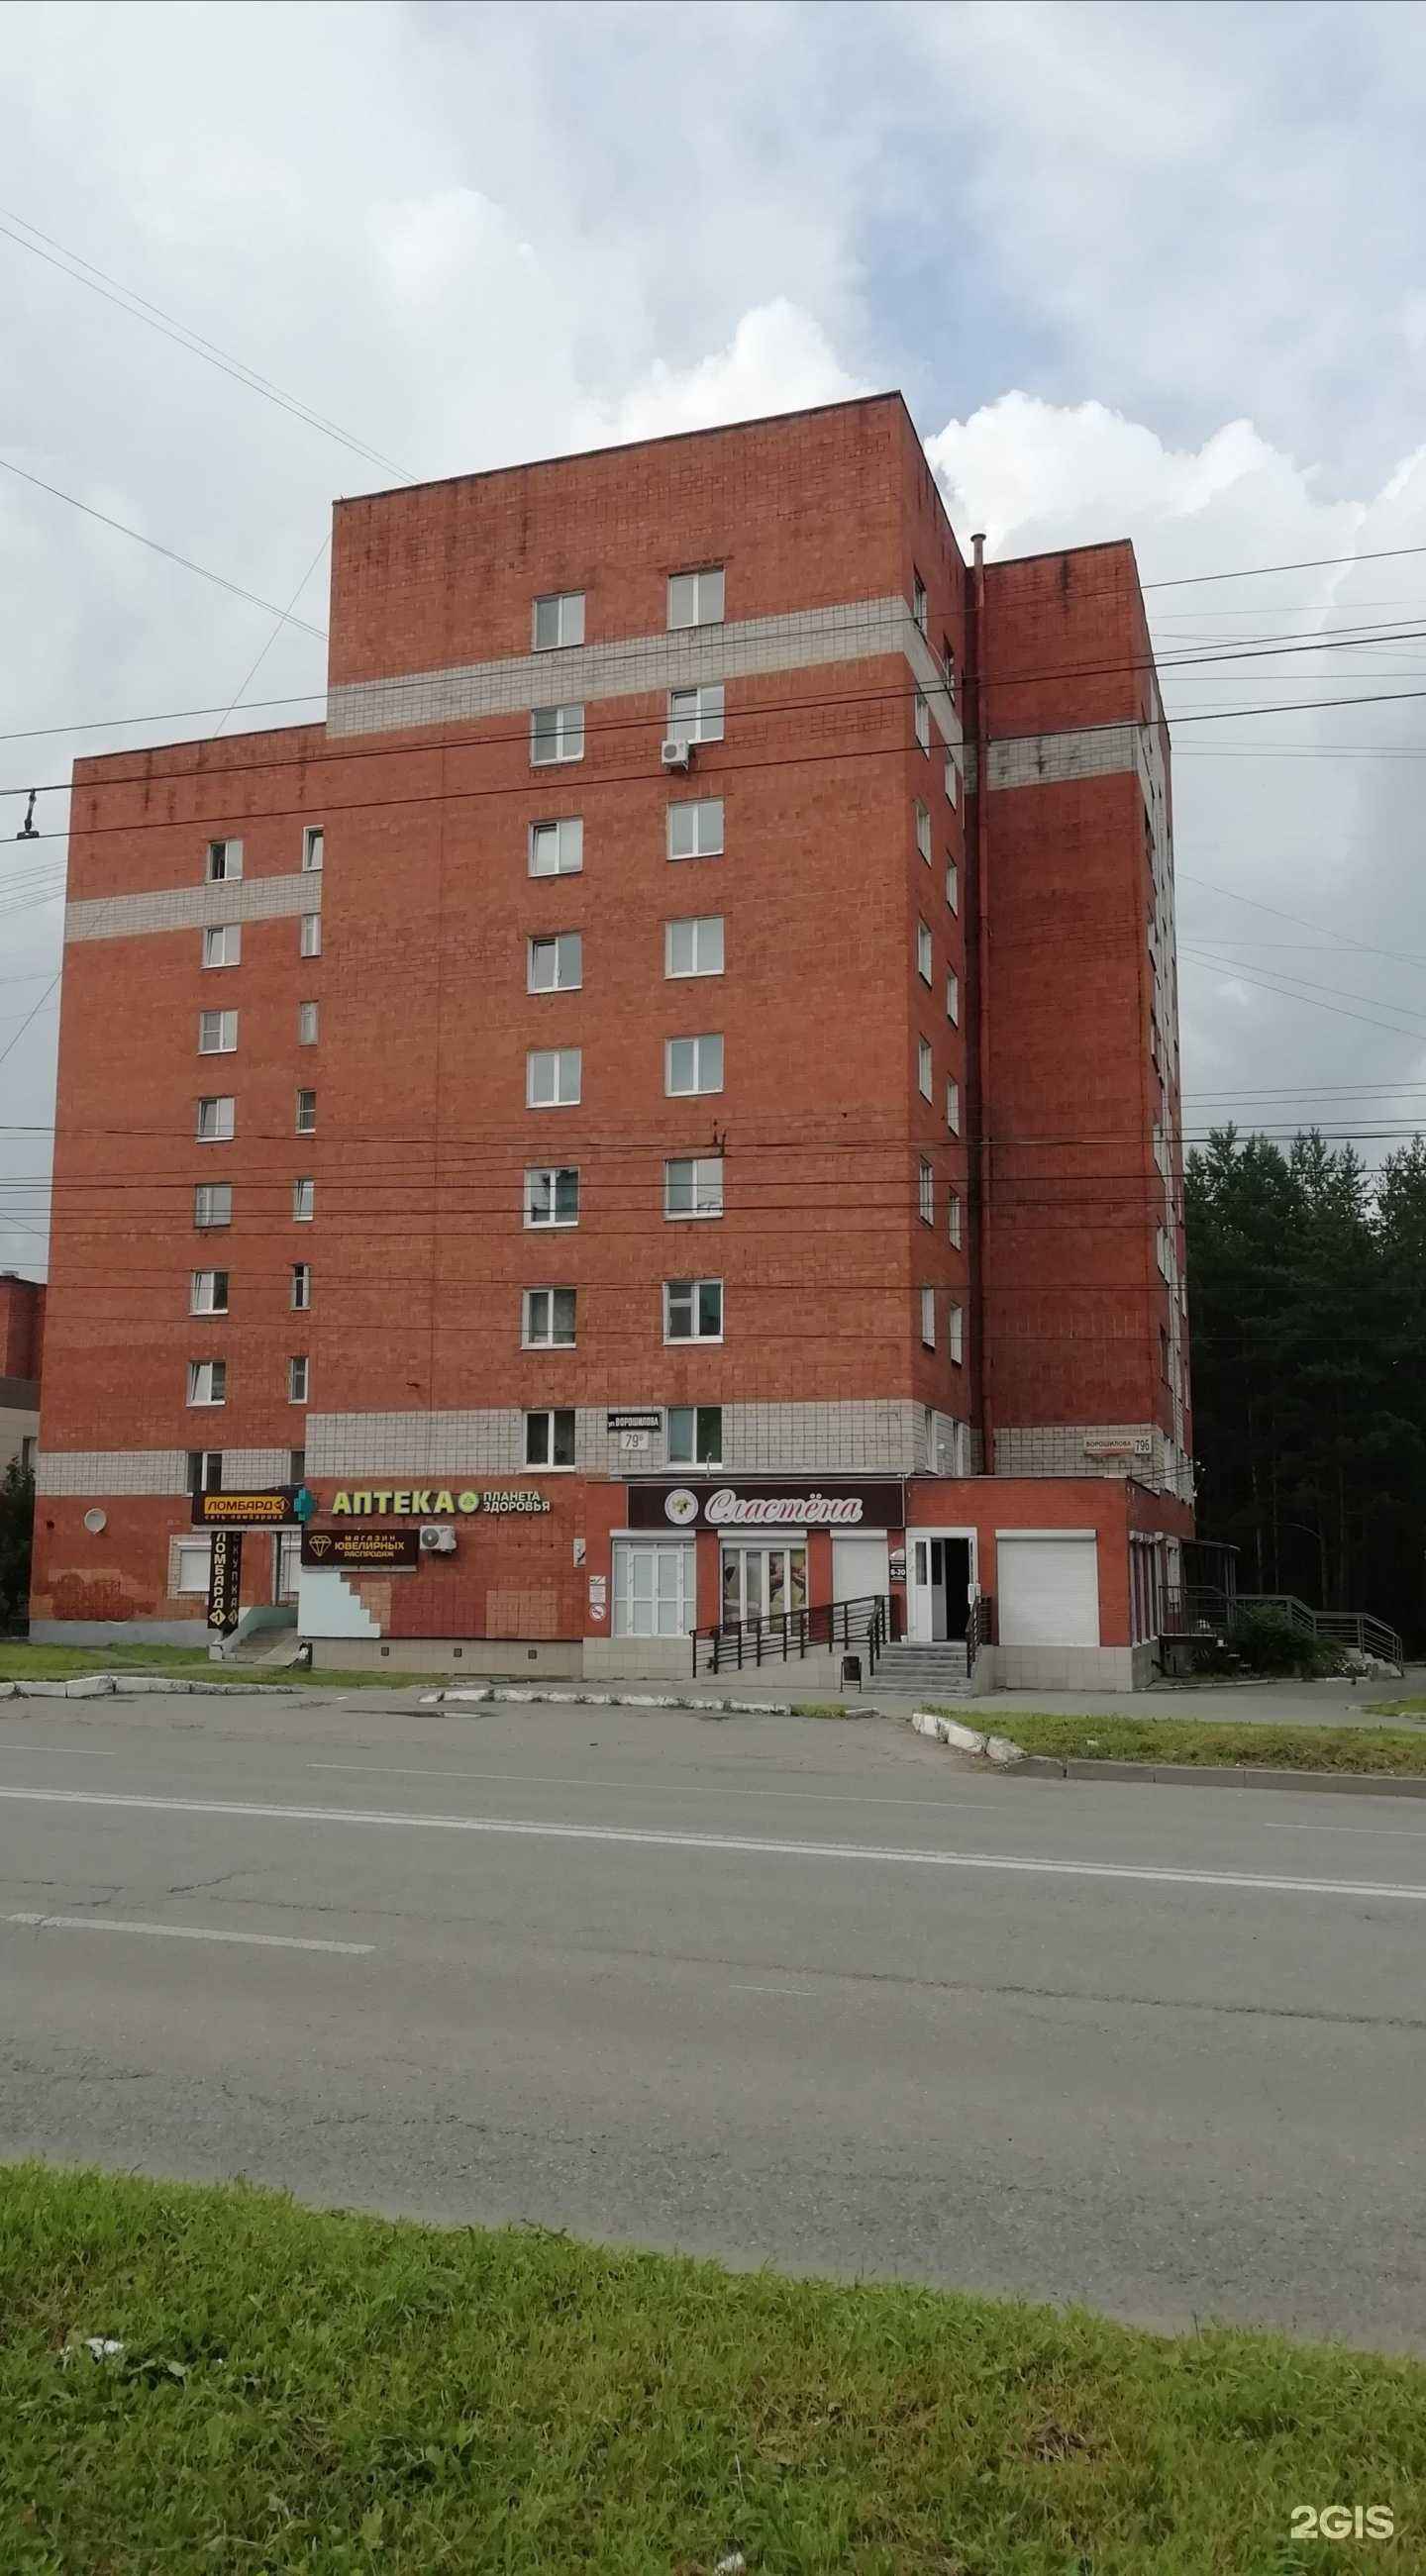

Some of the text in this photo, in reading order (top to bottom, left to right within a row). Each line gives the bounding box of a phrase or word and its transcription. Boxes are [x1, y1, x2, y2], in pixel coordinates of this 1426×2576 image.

[615, 1417, 660, 1427] ВОРОШИЛОВА
[482, 1491, 541, 1502] ПЛАНЕТА
[207, 1500, 273, 1511] ЛОМБАРД
[332, 1490, 456, 1515] АПТЕКА
[482, 1501, 551, 1513] ЗДОРОВЬЯ
[704, 1489, 864, 1524] Сластёна
[334, 1541, 404, 1550] ЮВЕЛИРНЫХ
[213, 1532, 227, 1609] ЛОМБАРД
